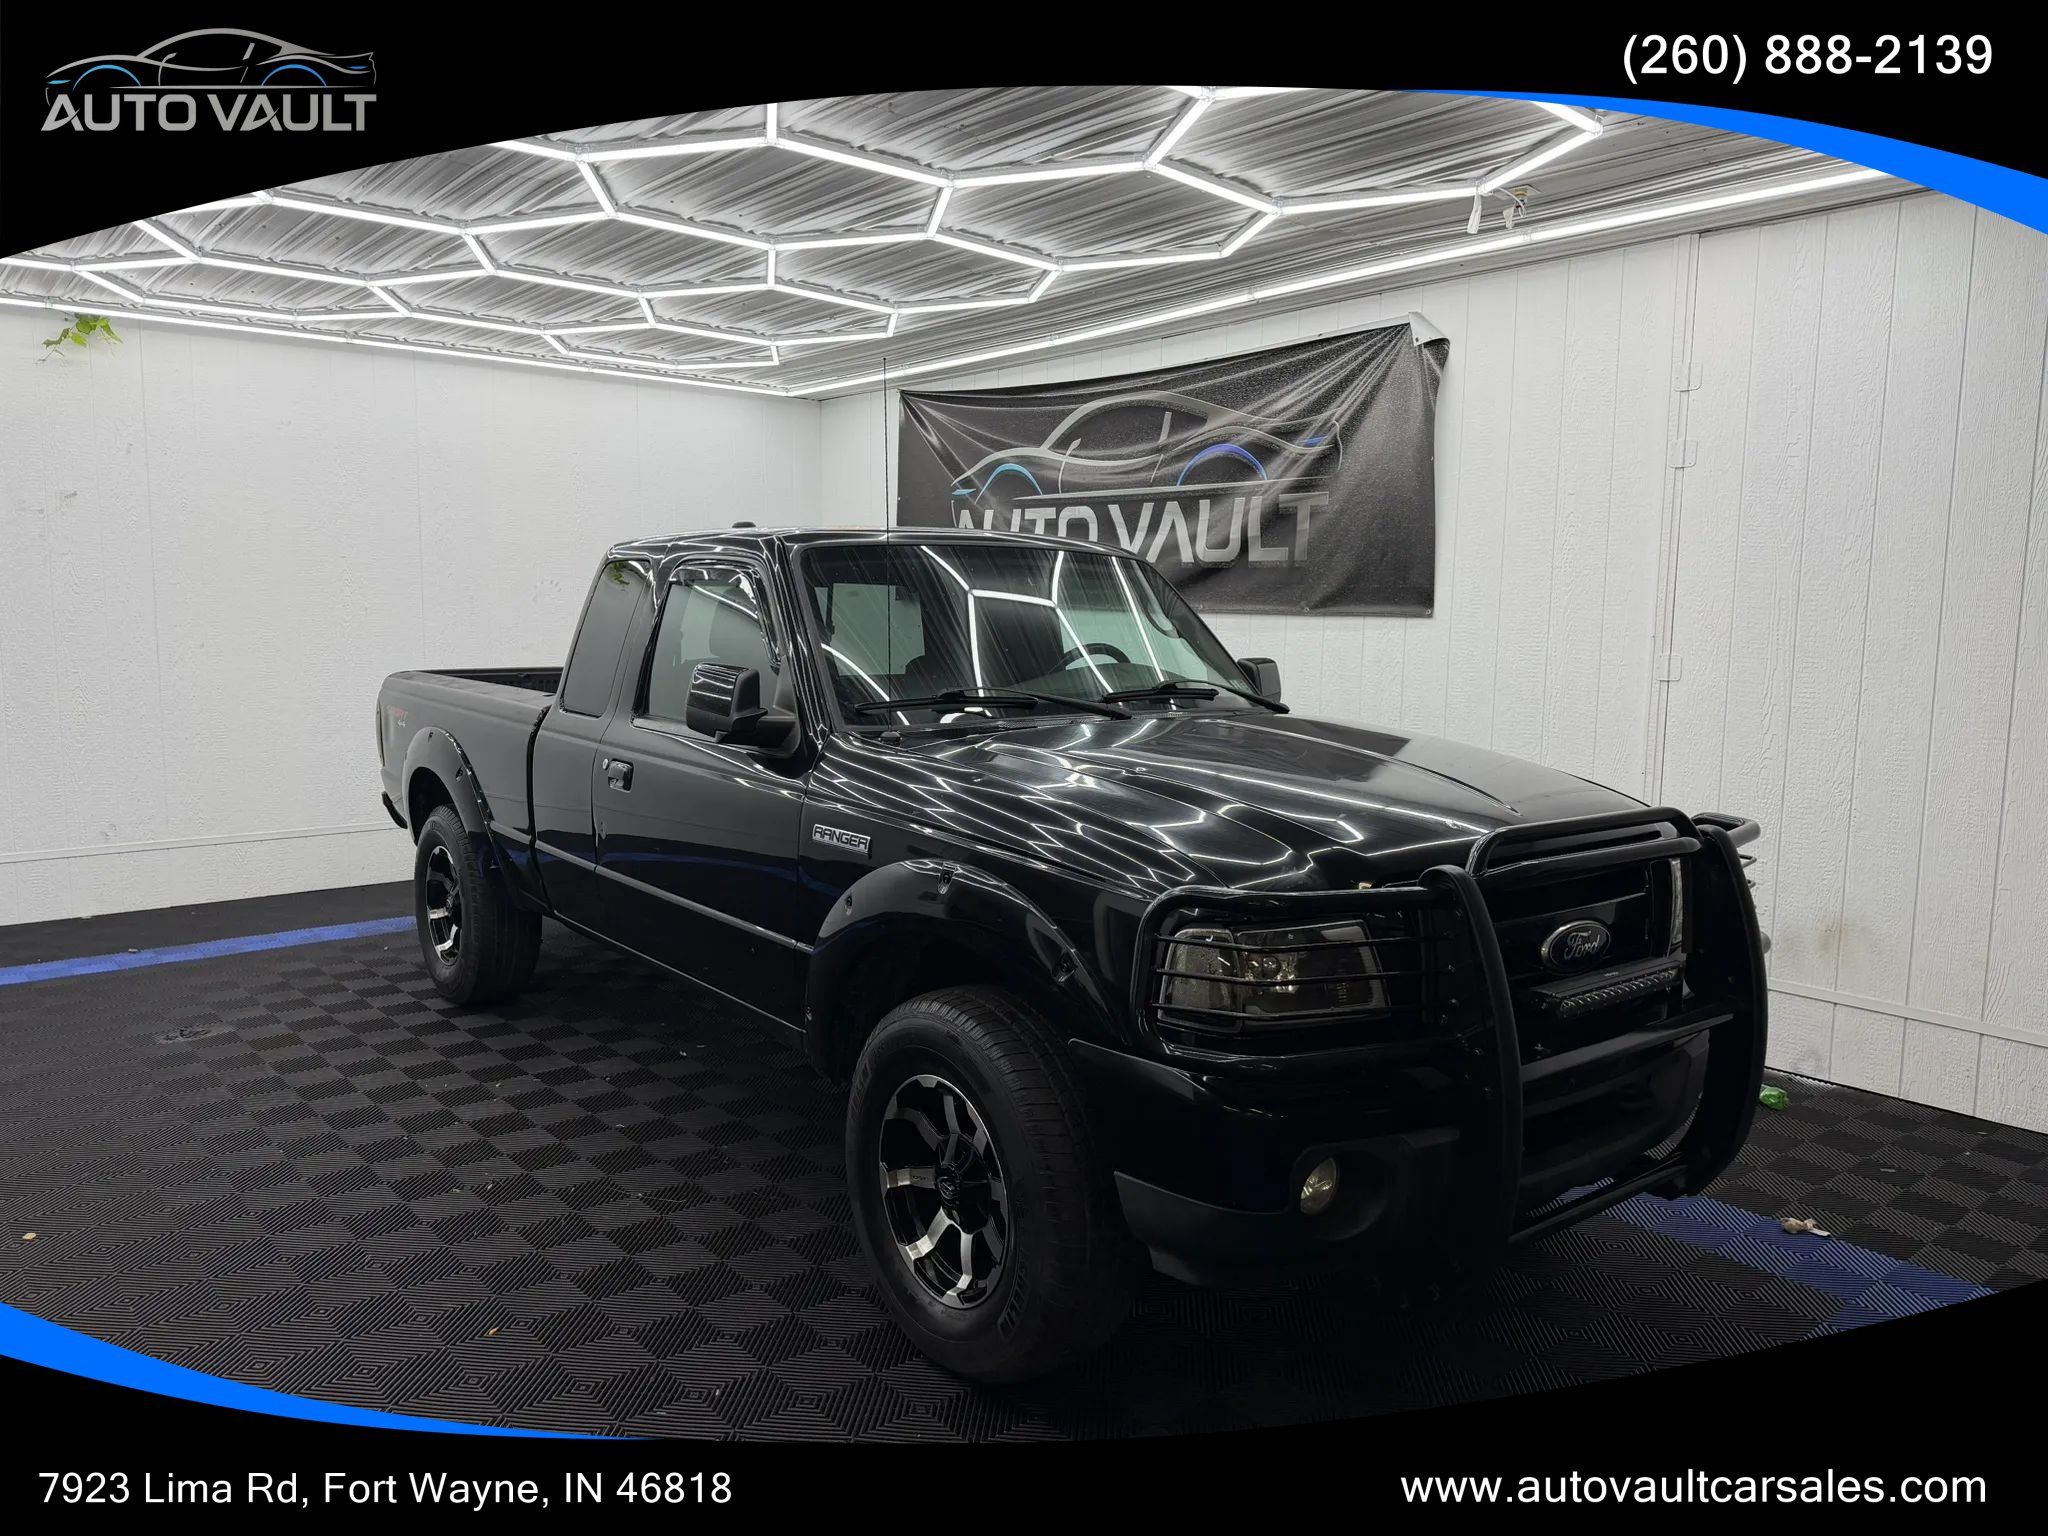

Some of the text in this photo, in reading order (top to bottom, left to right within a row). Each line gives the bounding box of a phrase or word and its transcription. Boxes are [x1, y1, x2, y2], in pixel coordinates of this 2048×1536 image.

[1107, 491, 1329, 564] VAULT
[813, 825, 869, 851] RANGER
[1563, 930, 1601, 960] Ford
